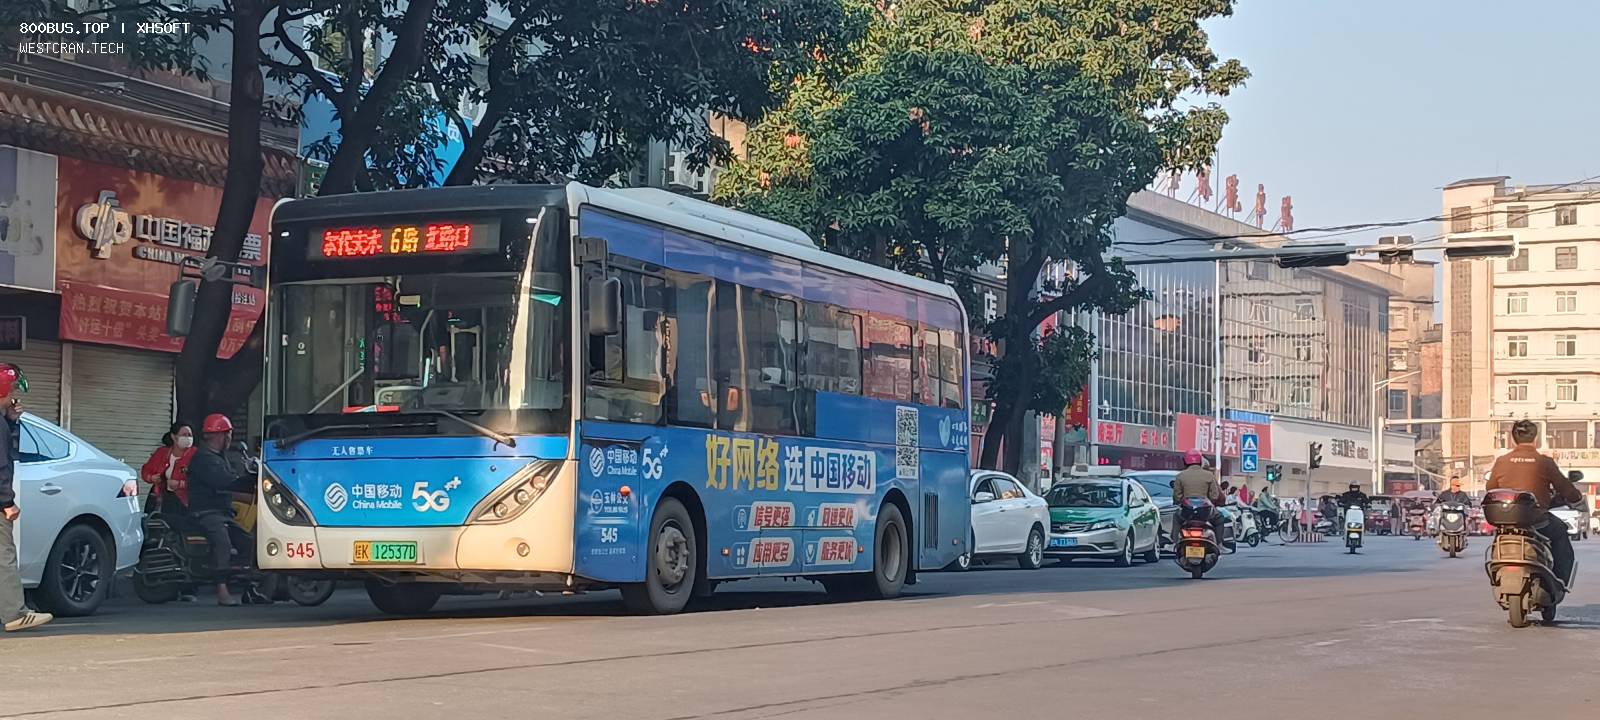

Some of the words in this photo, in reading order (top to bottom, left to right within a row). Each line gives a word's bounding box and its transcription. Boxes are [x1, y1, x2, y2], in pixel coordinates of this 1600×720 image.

[71, 293, 168, 321] 热烈祝贺本站
[705, 433, 780, 491] 好网络
[784, 445, 804, 491] 选
[810, 450, 871, 490] 中国移动
[351, 483, 403, 499] 中国移动
[352, 500, 376, 510] China
[376, 500, 403, 510] Mobile
[600, 527, 618, 543] 545
[286, 542, 315, 559] 545
